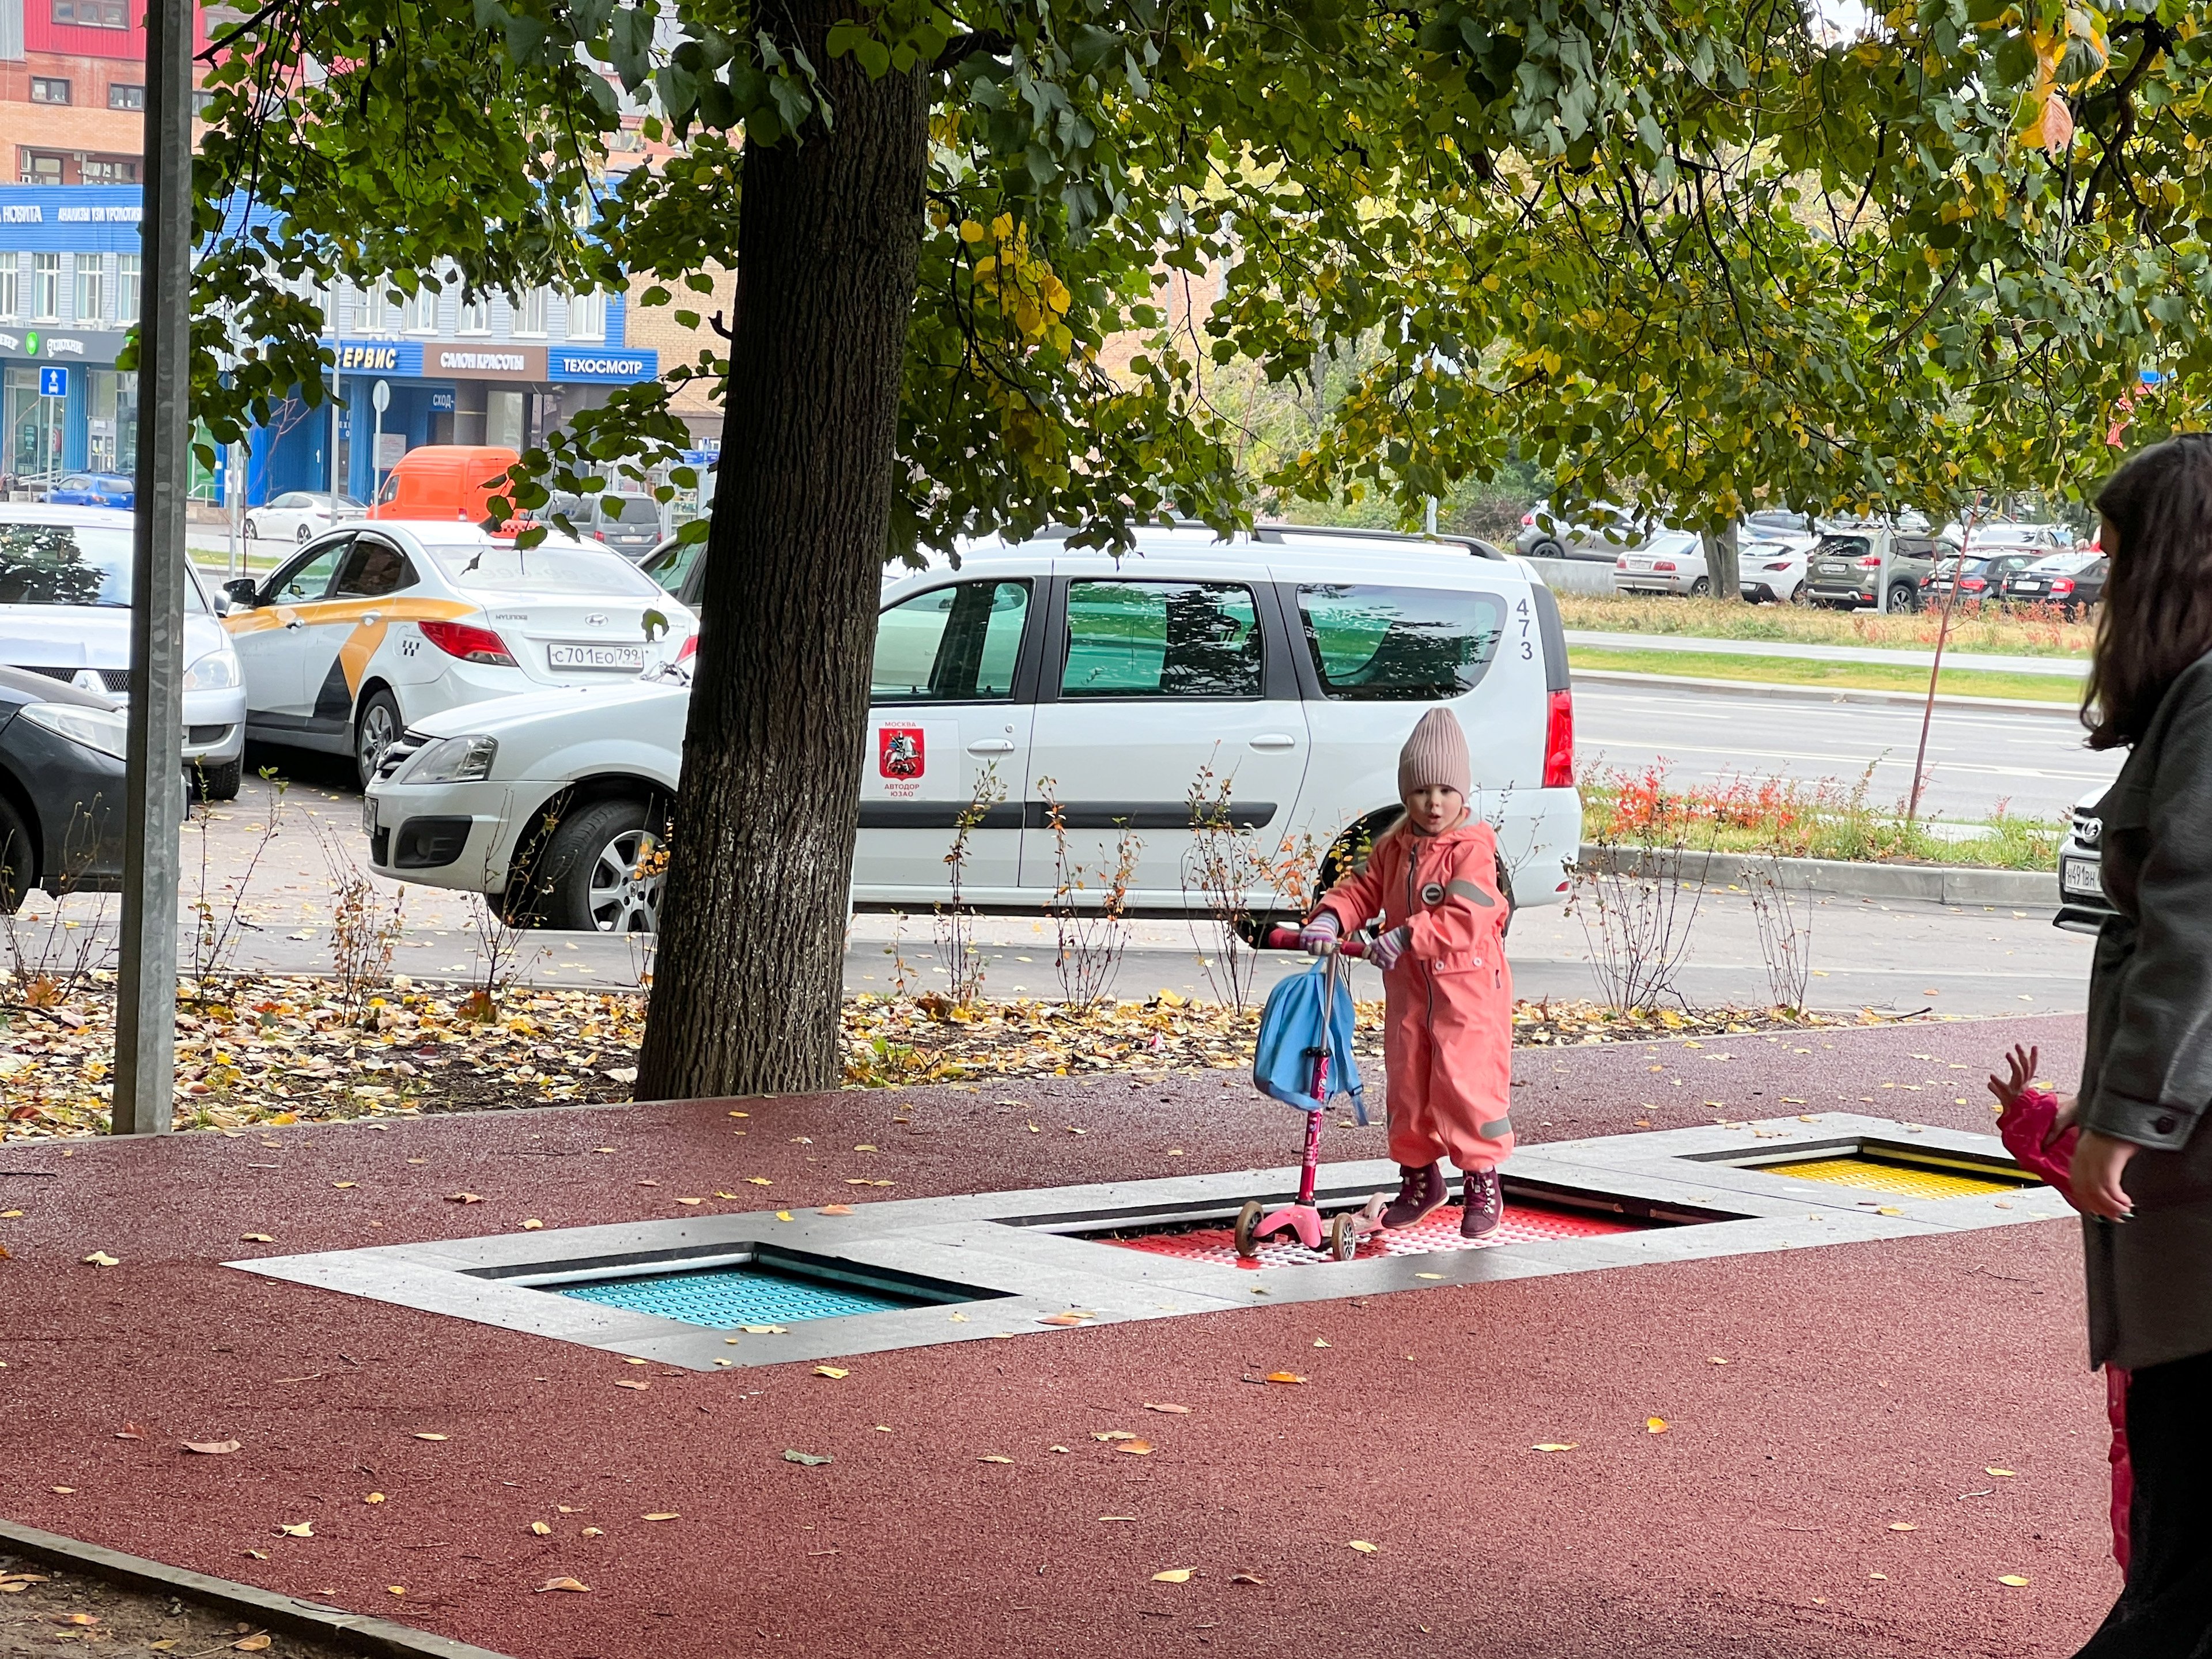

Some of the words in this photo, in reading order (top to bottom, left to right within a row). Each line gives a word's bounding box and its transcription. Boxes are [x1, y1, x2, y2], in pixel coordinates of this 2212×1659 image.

[2, 205, 43, 223] НОВИТА
[58, 207, 90, 222] АНАЛИЗЫ
[91, 207, 105, 222] УЗИ
[440, 352, 476, 369] САЛОН
[477, 353, 524, 371] КРАСОТЫ
[564, 358, 643, 375] ТЕХОСМОТР
[433, 394, 454, 409] СХОД-
[617, 648, 638, 660] 799
